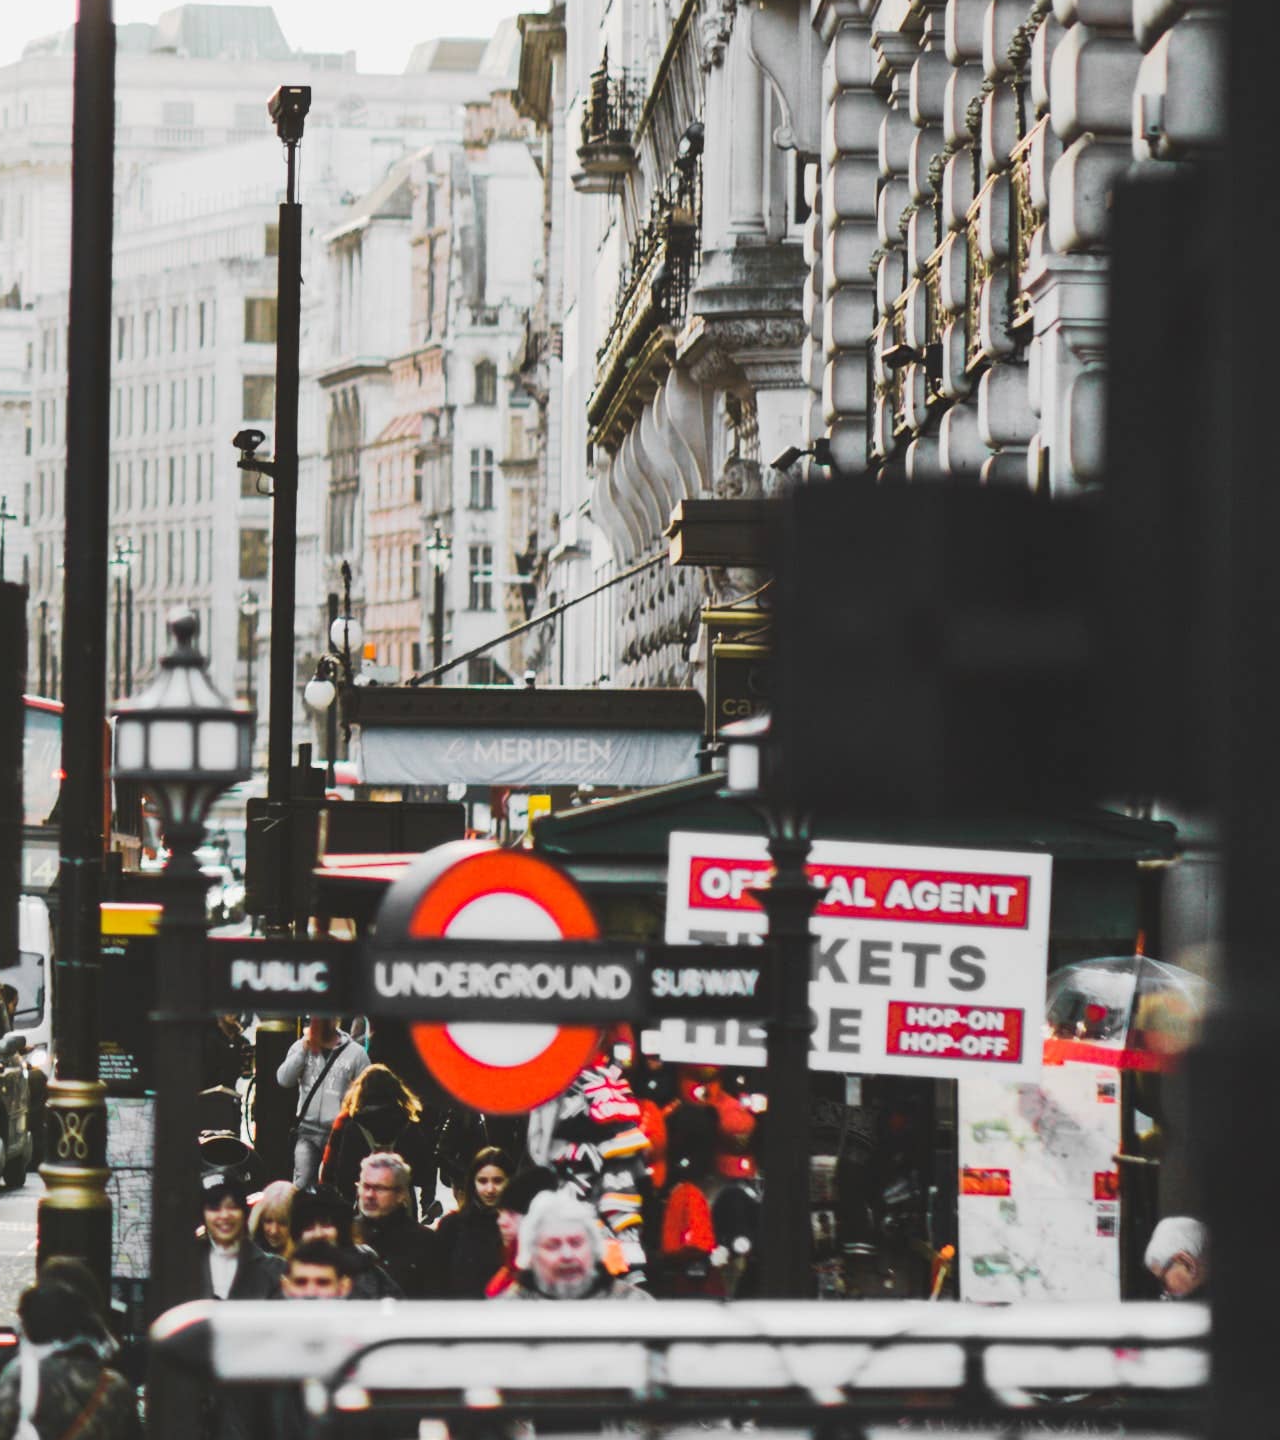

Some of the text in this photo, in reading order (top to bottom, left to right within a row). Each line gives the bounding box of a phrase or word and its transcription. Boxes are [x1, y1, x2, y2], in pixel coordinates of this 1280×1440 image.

[473, 737, 614, 765] MERIDIEN
[884, 881, 1018, 916] AGENT
[230, 960, 330, 993] PUBLIC
[374, 962, 632, 1000] UNDERGROUND
[650, 966, 760, 998] SUBWAY
[906, 1005, 1006, 1032] HOP-ON
[899, 1031, 1010, 1057] HOP-OFF
